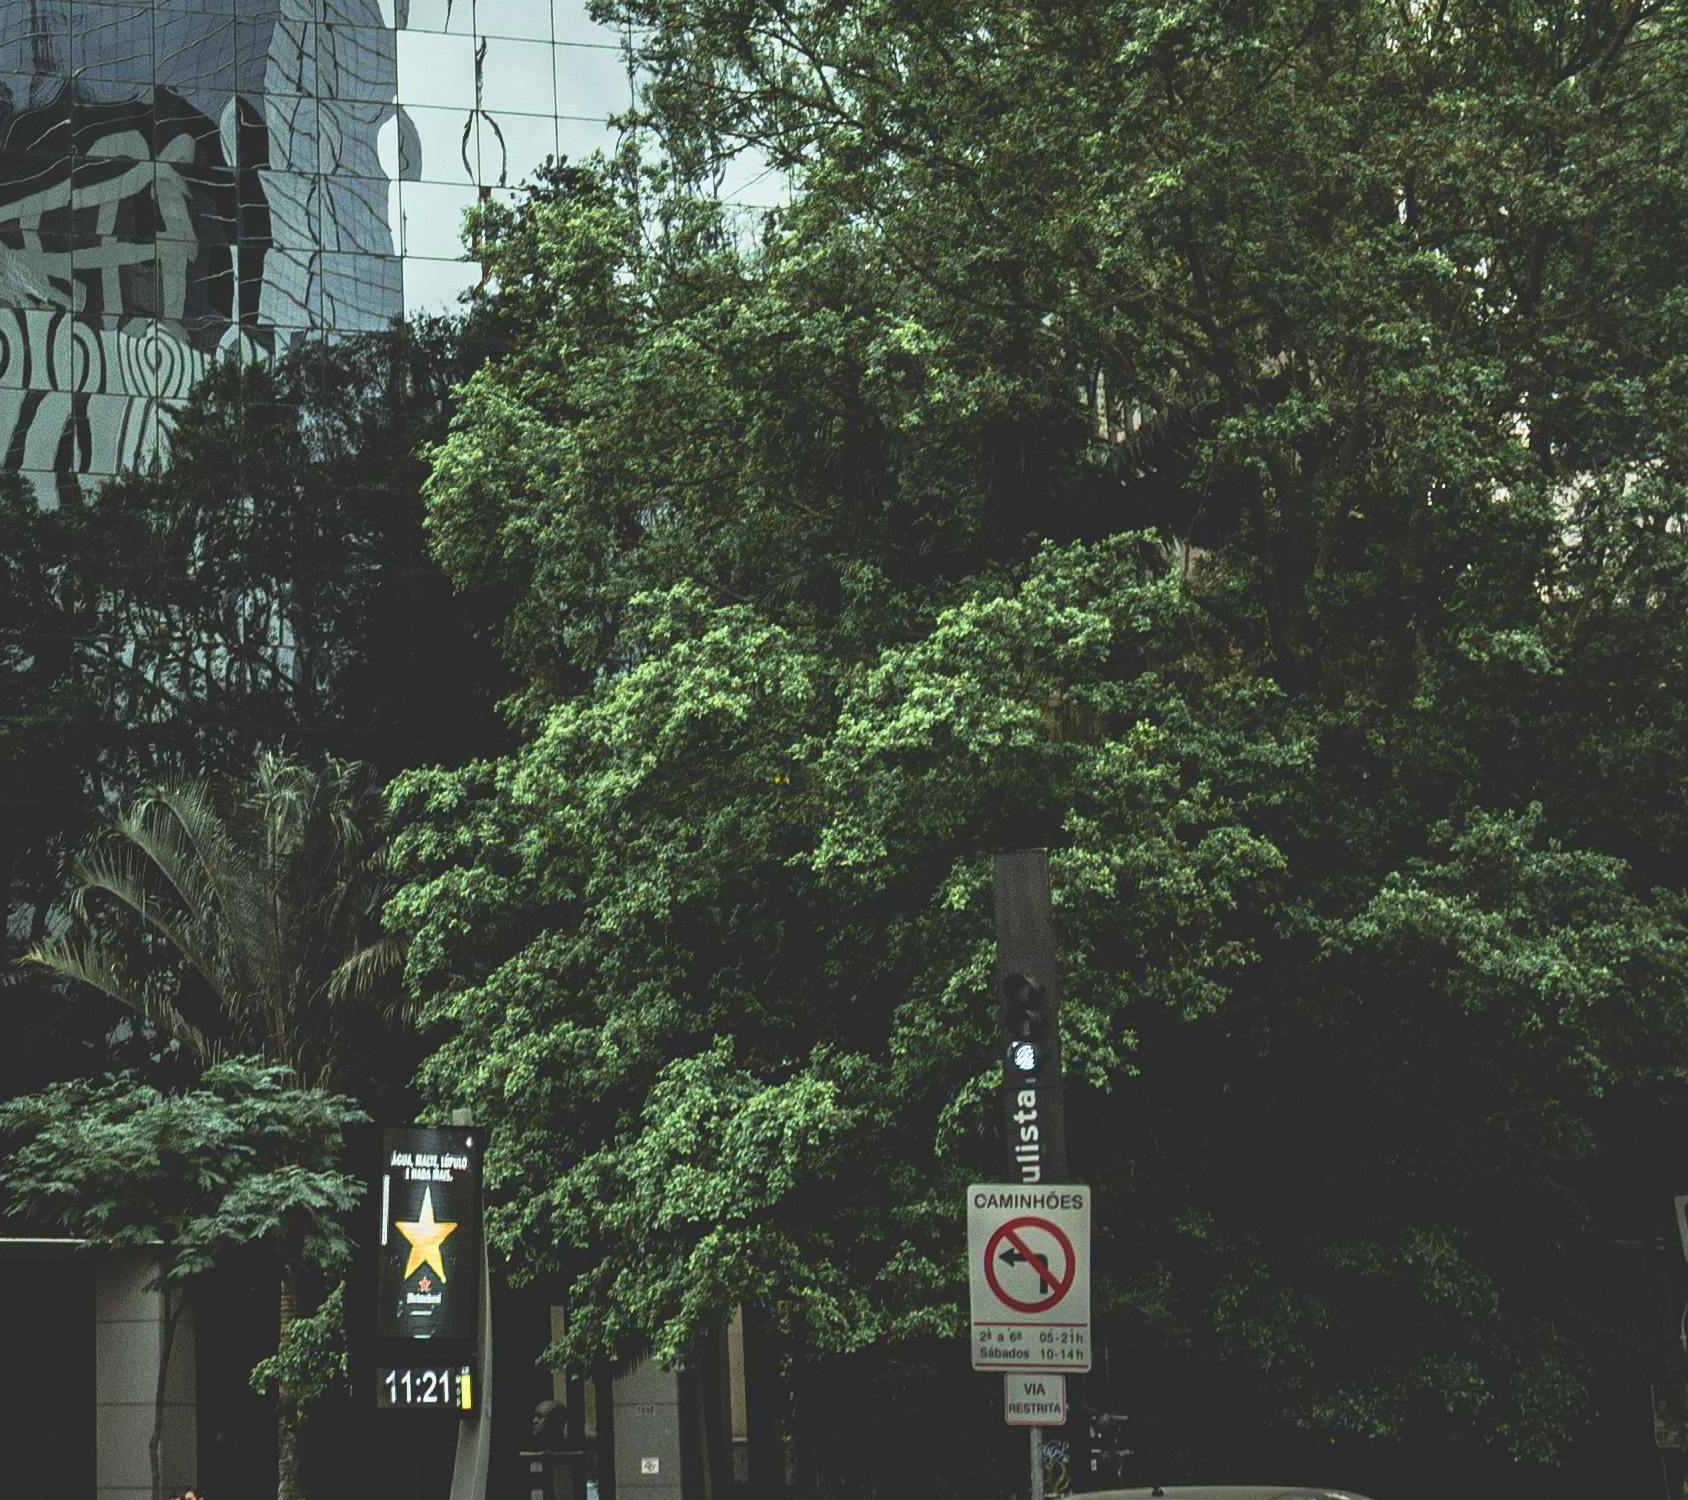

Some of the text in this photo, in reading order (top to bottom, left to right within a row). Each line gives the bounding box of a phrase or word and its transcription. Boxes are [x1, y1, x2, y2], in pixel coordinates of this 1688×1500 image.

[1013, 1090, 1041, 1184] ulista
[974, 1191, 1083, 1210] CAMINHÕES
[997, 1333, 1004, 1342] a
[980, 1346, 1030, 1359] Sábados
[385, 1369, 450, 1404] 11:21
[1023, 1383, 1046, 1395] VIA
[1009, 1403, 1061, 1414] RESTRITA
